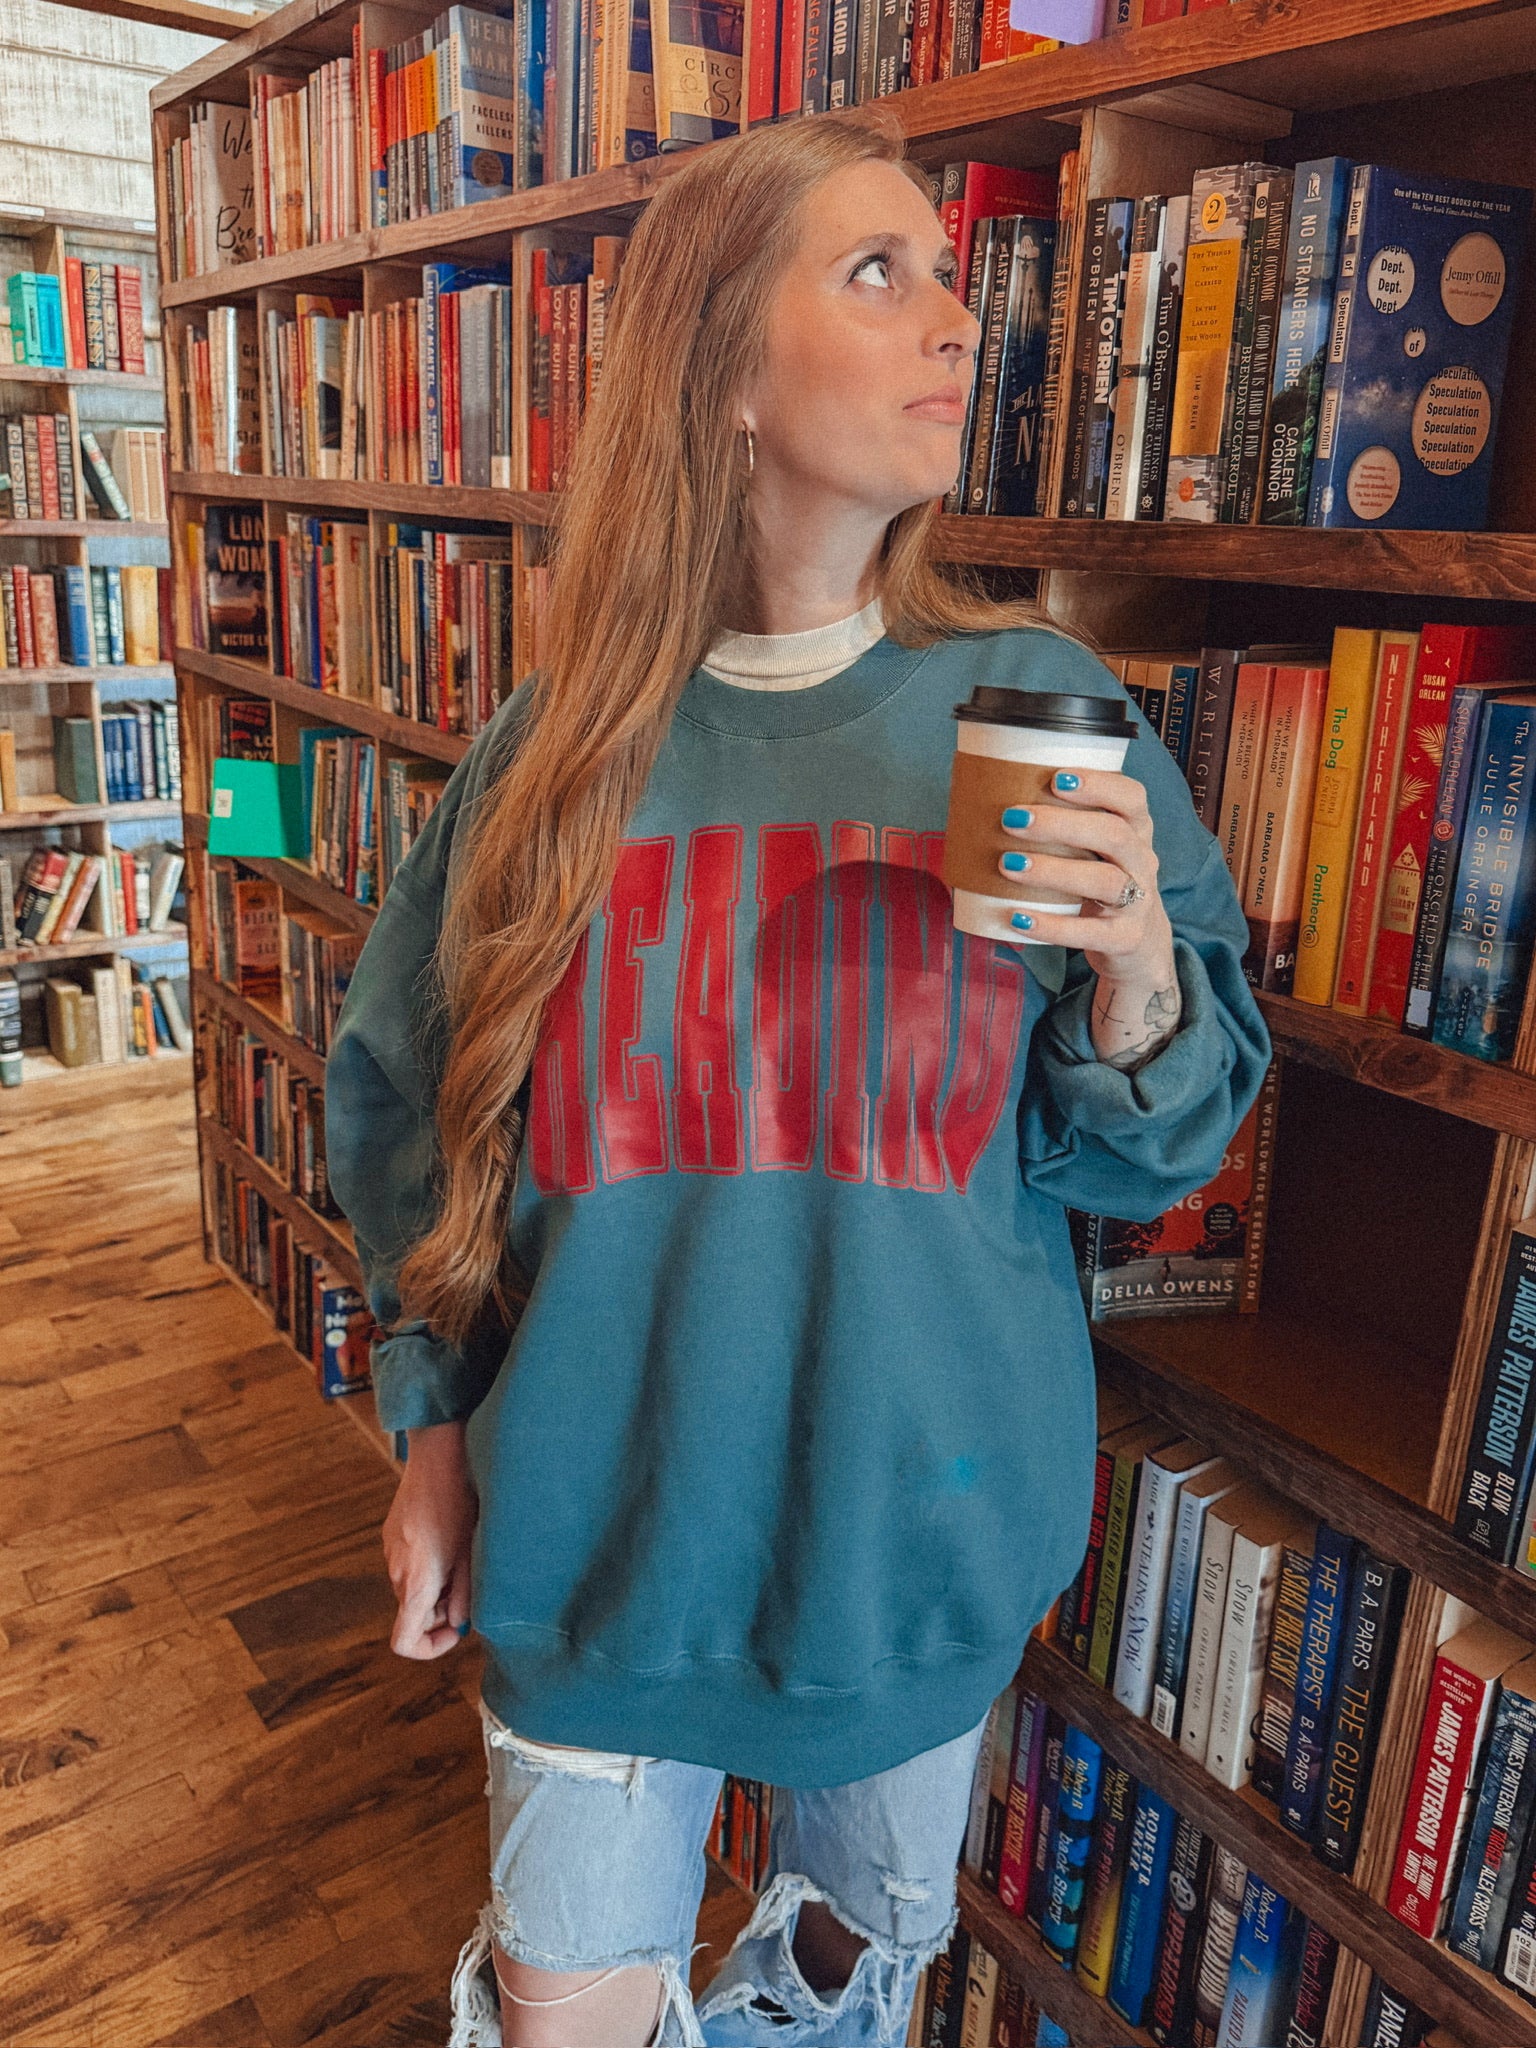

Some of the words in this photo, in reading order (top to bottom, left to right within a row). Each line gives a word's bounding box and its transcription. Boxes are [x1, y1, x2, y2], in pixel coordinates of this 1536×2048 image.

[833, 6, 848, 56] HOUR
[994, 6, 1008, 49] Alice
[806, 26, 819, 79] FALLS
[476, 124, 513, 140] KILLERS
[1095, 204, 1106, 237] TIM
[1208, 199, 1221, 226] 2
[1349, 200, 1362, 230] Dept.
[1421, 193, 1433, 201] TEN
[1435, 195, 1450, 204] BEST
[1451, 197, 1471, 207] BOOKS
[1482, 202, 1493, 210] THE
[1495, 204, 1511, 212] YEAR
[1264, 200, 1285, 253] FLANNERY
[1300, 213, 1317, 238] NO
[1086, 244, 1103, 321] O'BRIEN
[1260, 255, 1279, 303] O'CONNOR
[1344, 259, 1354, 271] of
[1380, 258, 1406, 275] Dept.
[1446, 266, 1474, 284] Jenny
[1476, 270, 1500, 284] Offill
[1102, 274, 1119, 313] TIM
[1288, 245, 1314, 341] STRANGERS
[1377, 278, 1403, 294] Dept.
[426, 281, 434, 332] HILARY
[553, 290, 561, 330] LOVE
[569, 290, 578, 330] LOVE
[1158, 292, 1174, 326] Tim
[1257, 313, 1267, 326] A
[1085, 337, 1092, 351] IN
[1259, 325, 1272, 350] GOOD
[1332, 296, 1350, 358] Speculation
[1409, 340, 1420, 353] of
[427, 336, 435, 388] MANTEL
[552, 343, 561, 380] RUIN
[568, 343, 578, 381] RUIN
[1094, 315, 1115, 405] O'BRIEN
[1151, 330, 1172, 392] O'Brien
[1255, 351, 1269, 376] MAN
[1283, 347, 1302, 388] HERE
[1080, 372, 1089, 403] LAKE
[1234, 346, 1251, 419] BRENDAN
[1253, 378, 1266, 390] IS
[1430, 384, 1482, 400] Speculation
[1078, 408, 1086, 420] OF
[1146, 398, 1158, 430] THEY
[1154, 404, 1166, 430] THE
[1248, 392, 1265, 419] HARD
[1427, 402, 1479, 417] Speculation
[1247, 420, 1258, 433] TO
[1424, 420, 1476, 436] Speculation
[1071, 445, 1083, 480] WOODS
[1110, 434, 1126, 496] O'BRIEN
[1140, 433, 1153, 489] CARRIED
[1150, 433, 1162, 481] THINGS
[1227, 419, 1243, 501] O'CARROLL
[1243, 436, 1257, 458] FIND
[1266, 422, 1286, 503] O'CONNOR
[1279, 427, 1299, 499] CARLENE
[1421, 439, 1473, 454] Speculation
[1418, 687, 1446, 702] ORLEAN
[1422, 673, 1446, 687] SUSAN
[1241, 711, 1249, 720] IN
[1247, 700, 1258, 725] WHEN
[1276, 717, 1284, 727] IN
[1283, 706, 1294, 732] WHEN
[1331, 707, 1348, 734] The
[1450, 706, 1469, 754] SUSAN
[1235, 723, 1248, 767] MERMAIDS
[1246, 729, 1255, 741] WE
[1269, 729, 1283, 774] MERMAIDS
[1281, 736, 1291, 748] WE
[1514, 721, 1530, 745] The
[1241, 744, 1253, 780] BELIEVED
[1276, 751, 1288, 788] BELIEVED
[1325, 738, 1344, 769] Dog
[1360, 654, 1401, 887] NETHERLAND
[1327, 779, 1341, 815] JOSEPH
[1440, 759, 1461, 815] ORLEAN
[1479, 754, 1500, 815] JULIE
[1227, 803, 1241, 855] BARBARA
[1493, 754, 1527, 872] INVISIBLE
[1260, 811, 1275, 863] BARBARA
[1254, 866, 1268, 908] O'NEAL
[1459, 826, 1488, 933] ORRINGER
[1474, 882, 1507, 970] BRIDGE
[1255, 1102, 1273, 1202] WORLDWIDE
[1085, 1243, 1095, 1277] SING
[1246, 1212, 1264, 1301] SENSATION
[1102, 1284, 1155, 1301] DELIA
[1163, 1279, 1235, 1295] OWENS
[1507, 1275, 1536, 1351] JAMES
[1484, 1349, 1535, 1468] PATTERSON
[1467, 1470, 1491, 1511] BACK
[1492, 1471, 1516, 1516] BLOW
[1277, 1568, 1310, 1612] SARA
[1317, 1553, 1341, 1596] THE
[1364, 1569, 1384, 1588] B.
[1358, 1591, 1380, 1611] A.
[1269, 1598, 1306, 1690] PARETSKY
[1304, 1600, 1336, 1711] THERAPIST
[1352, 1613, 1376, 1671] PARIS
[1227, 1648, 1239, 1689] ORHAN
[1443, 1666, 1452, 1676] THE
[1440, 1680, 1473, 1703] BESTSELLING
[1445, 1689, 1466, 1706] WRITER
[1218, 1692, 1234, 1737] PAMUK
[1259, 1694, 1294, 1759] FALLOUT
[1300, 1715, 1315, 1733] B.
[1338, 1684, 1370, 1741] THE
[1432, 1700, 1463, 1764] JAMES
[1292, 1746, 1313, 1794] PARIS
[1508, 1729, 1531, 1772] JAMES
[1325, 1745, 1361, 1832] GUEST
[1415, 1764, 1452, 1851] PATTERSON
[1492, 1768, 1519, 1829] PATTERSON
[1055, 1832, 1074, 1869] back
[1129, 1807, 1143, 1874] PARKER
[1143, 1807, 1161, 1874] ROBERT
[1402, 1848, 1423, 1882] LAWYER
[1423, 1852, 1438, 1873] THE
[1478, 1863, 1500, 1899] ALEX
[1048, 1871, 1069, 1926] Story
[1244, 1882, 1257, 1924] Parker
[1415, 1868, 1436, 1901] FAMILY
[1260, 1887, 1278, 1926] Robert
[1469, 1896, 1491, 1932] CROSS
[1199, 1899, 1239, 2008] REVELATION
[1256, 1927, 1268, 1944] B.
[1515, 1934, 1532, 1948] 102
[1230, 1988, 1249, 2038] PAINTED
